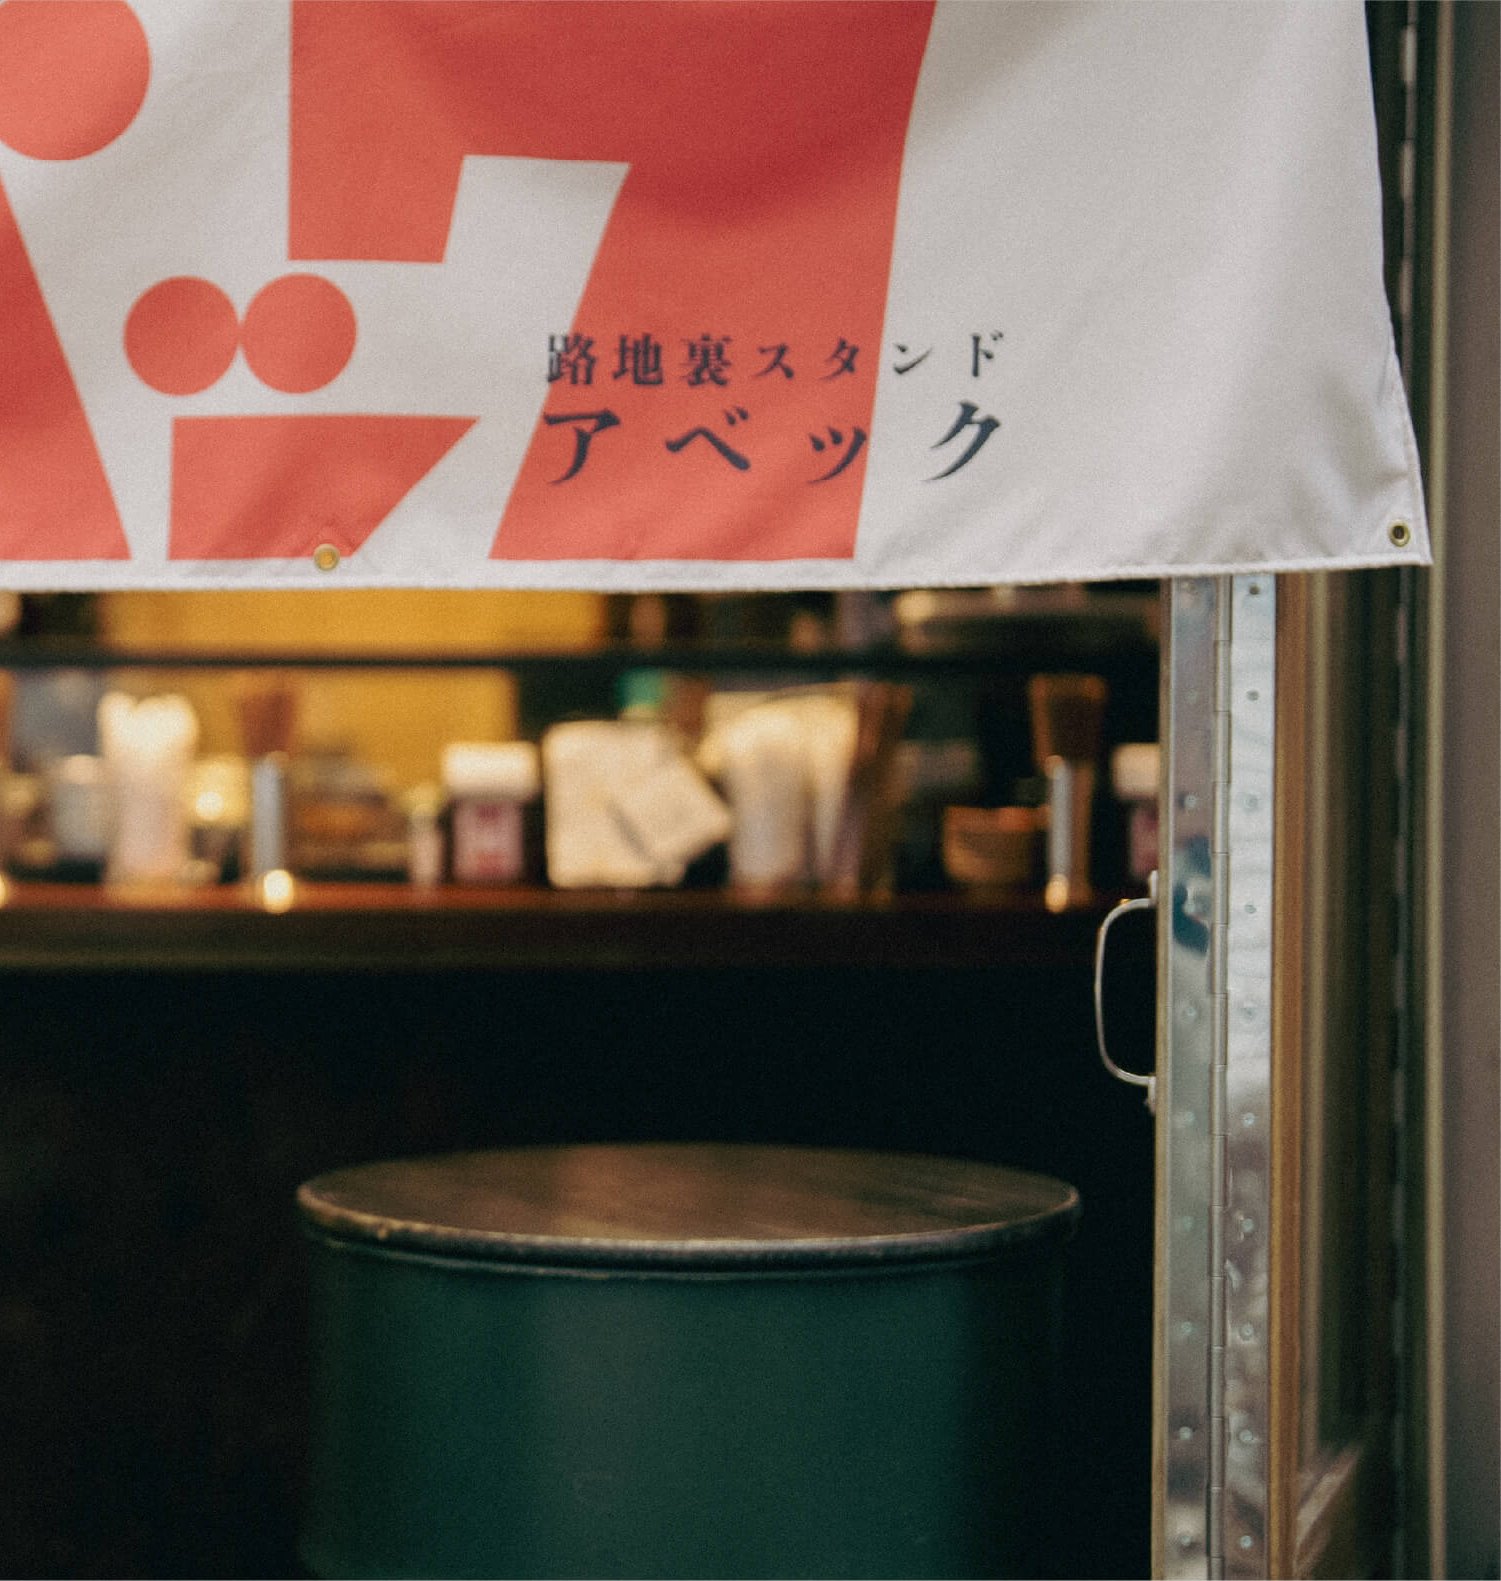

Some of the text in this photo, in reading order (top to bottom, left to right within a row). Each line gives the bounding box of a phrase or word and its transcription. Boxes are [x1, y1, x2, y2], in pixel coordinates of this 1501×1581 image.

[546, 331, 1005, 386] 路地裏スタンド
[543, 400, 1001, 485] アベック
